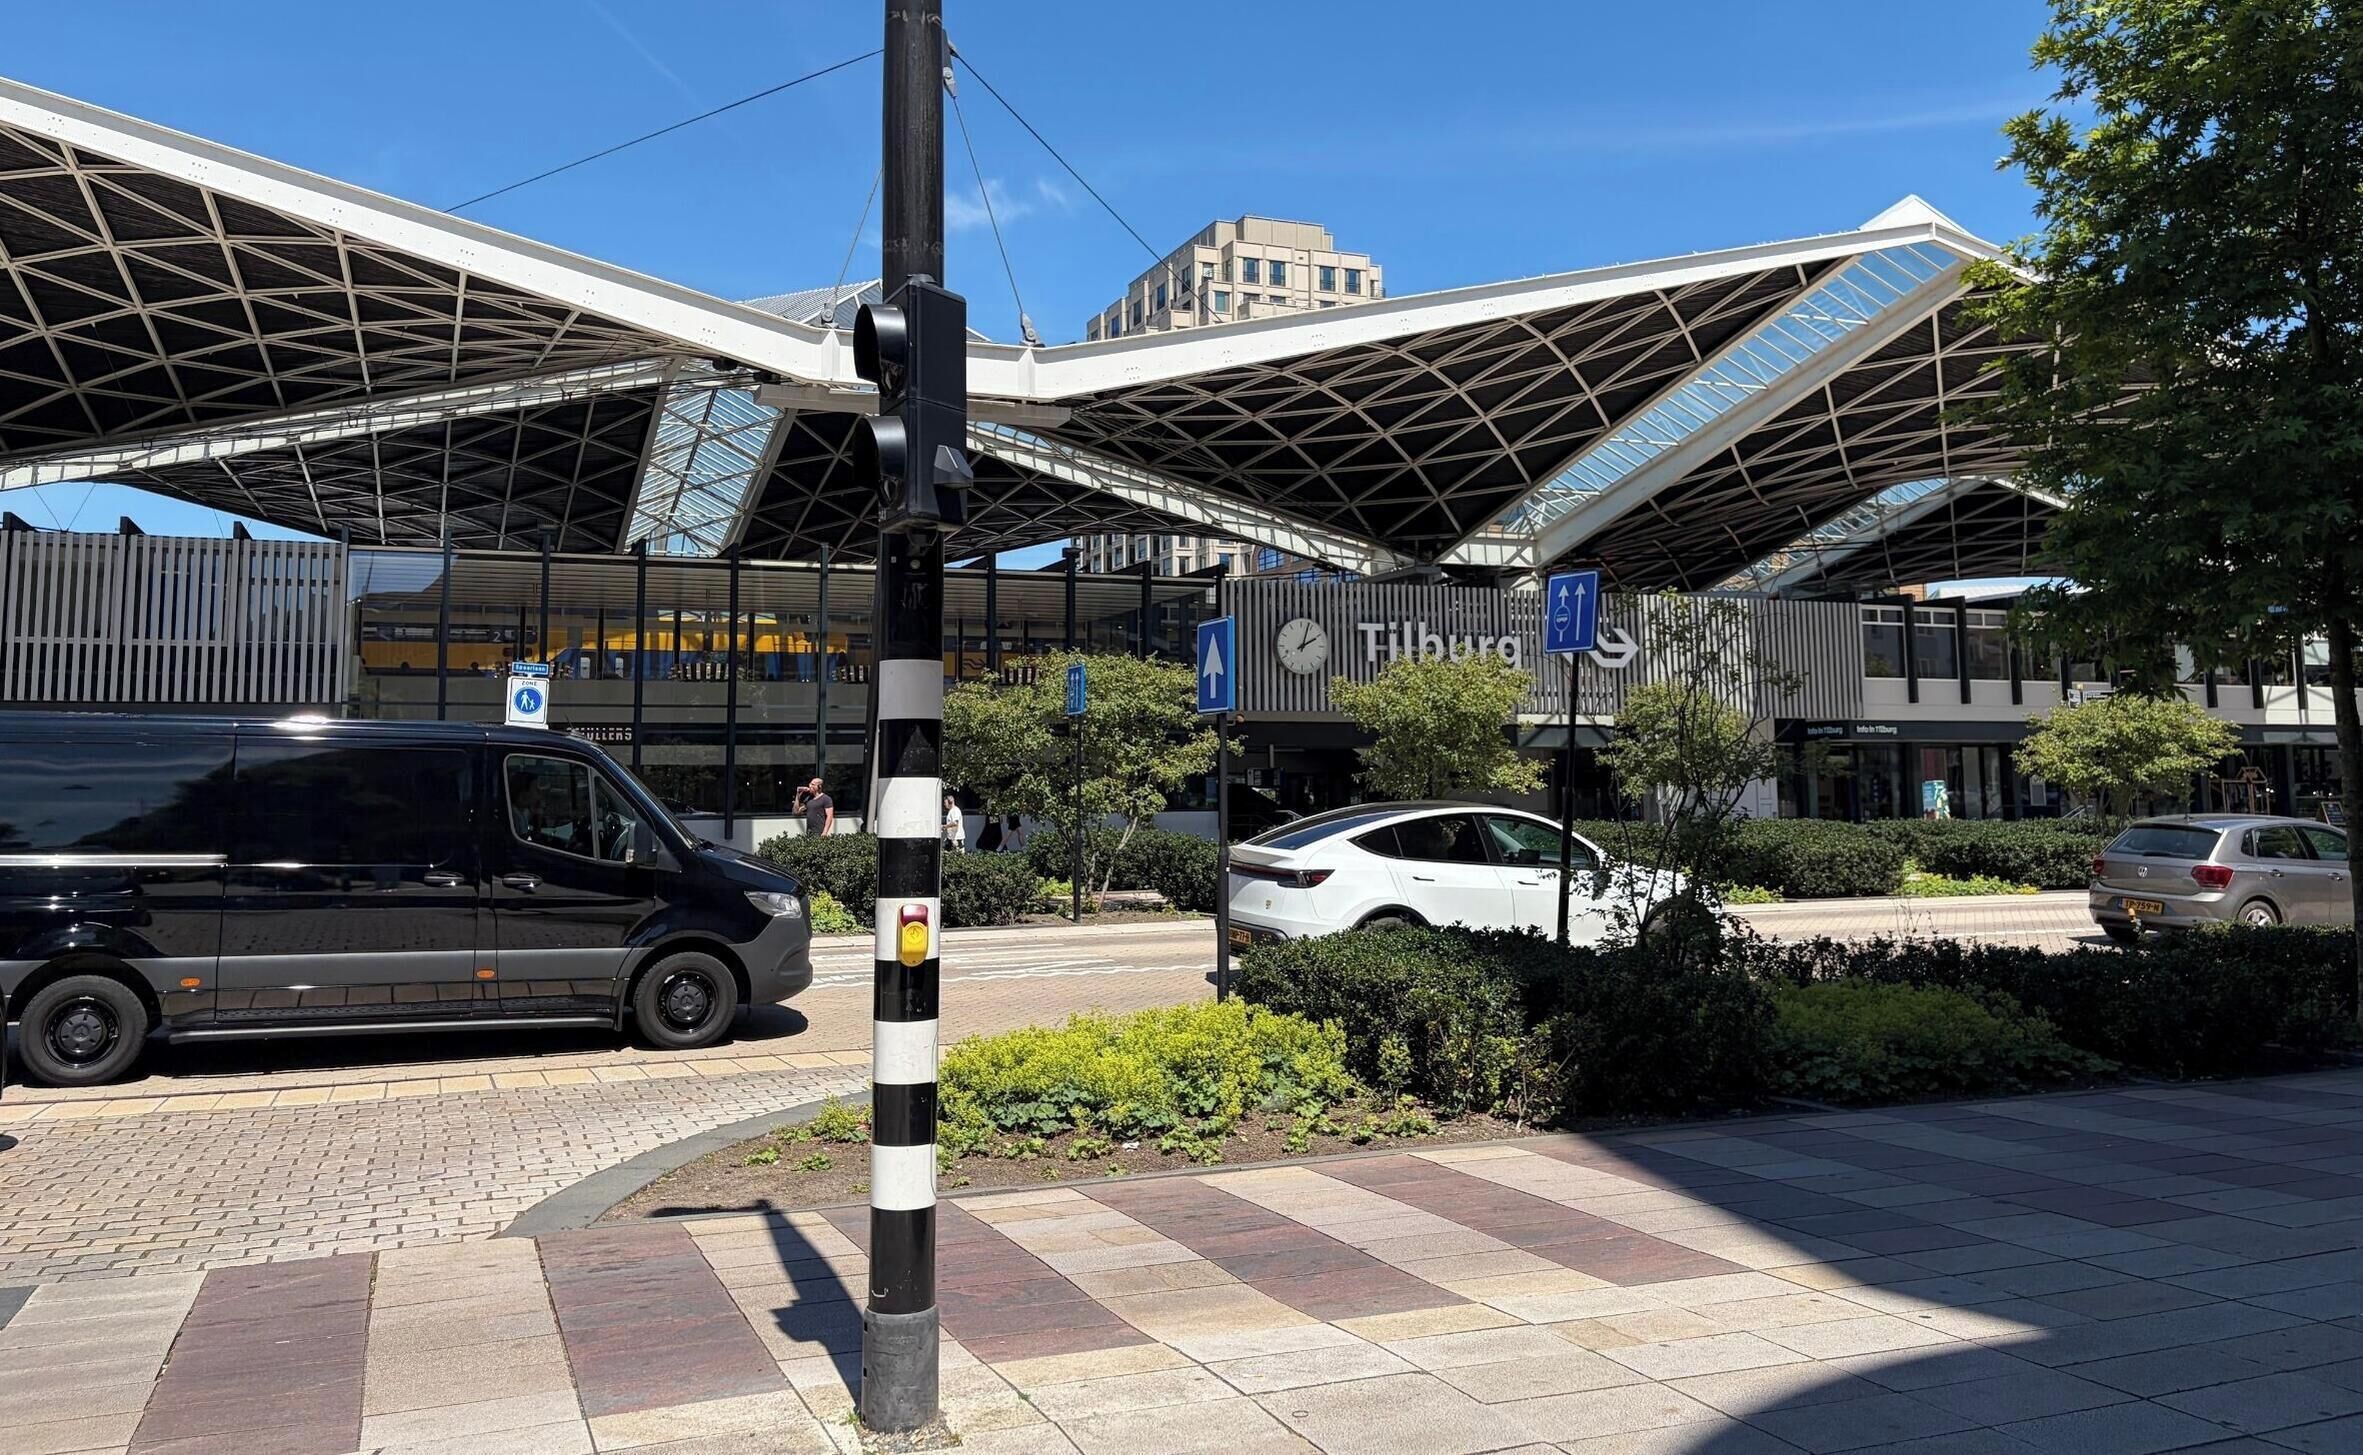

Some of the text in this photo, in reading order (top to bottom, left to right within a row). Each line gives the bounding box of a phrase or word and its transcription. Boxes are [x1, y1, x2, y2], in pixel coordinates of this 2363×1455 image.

[493, 631, 502, 643] 2
[1357, 620, 1522, 670] Tilburg
[1856, 725, 1869, 733] Info
[1875, 725, 1897, 735] Tilburg
